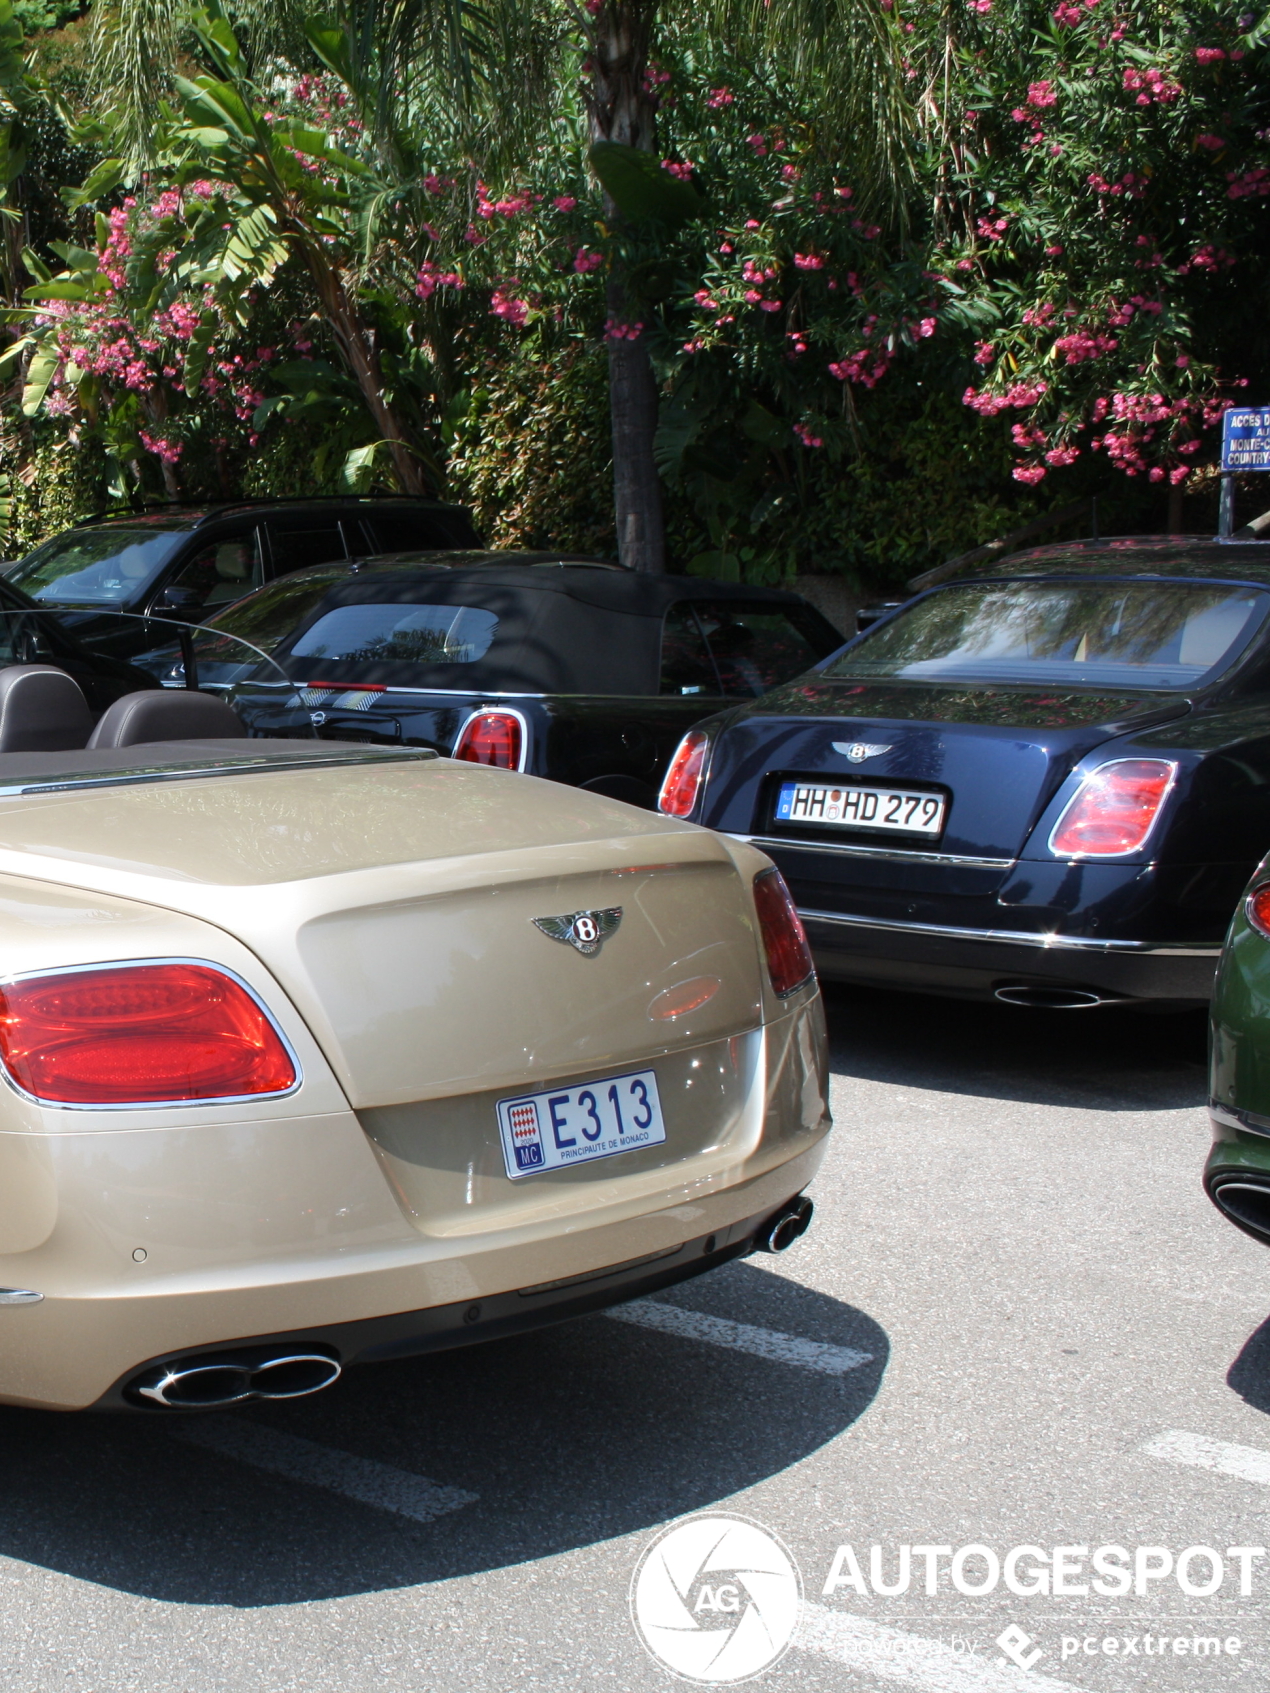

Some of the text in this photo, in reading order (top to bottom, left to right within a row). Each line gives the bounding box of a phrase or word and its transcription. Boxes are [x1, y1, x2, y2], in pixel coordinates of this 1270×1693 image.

[781, 804, 789, 813] D
[793, 788, 939, 826] HH HD 279
[548, 1079, 652, 1150] E313
[608, 1139, 618, 1149] DE
[620, 1132, 649, 1146] MONACO
[520, 1146, 538, 1165] MC
